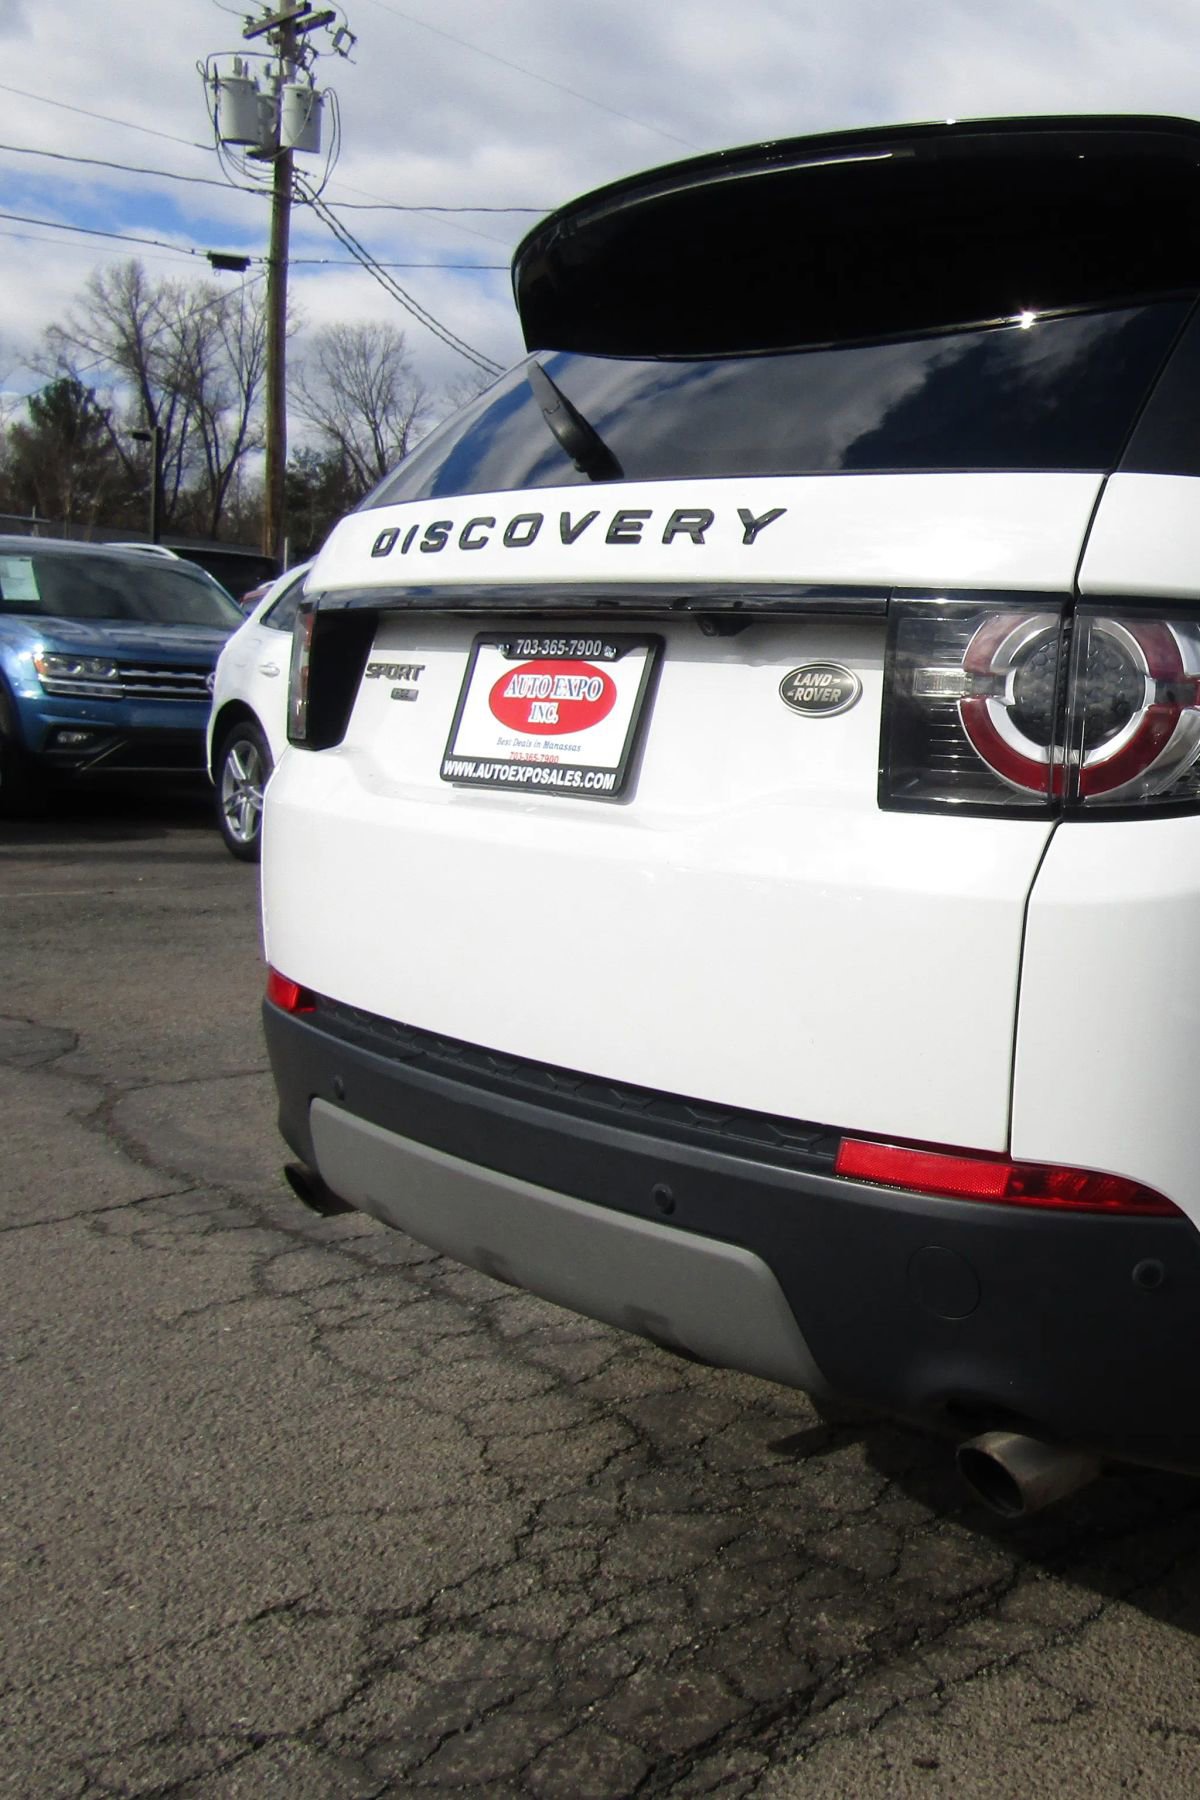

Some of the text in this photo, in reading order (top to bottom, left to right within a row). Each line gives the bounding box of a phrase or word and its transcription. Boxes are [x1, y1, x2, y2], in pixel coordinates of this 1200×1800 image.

[371, 508, 788, 558] DISCOVERY
[516, 639, 602, 656] 703-365-7900
[365, 663, 426, 681] SPORT
[793, 673, 833, 687] LAND
[504, 675, 604, 701] AUTO EXPO
[794, 687, 842, 702] ROVER
[529, 703, 559, 723] INC.
[513, 738, 532, 748] Deals
[543, 741, 582, 752] Manassas
[443, 760, 616, 790] WWW.AUTOEXPOSALES.COM
